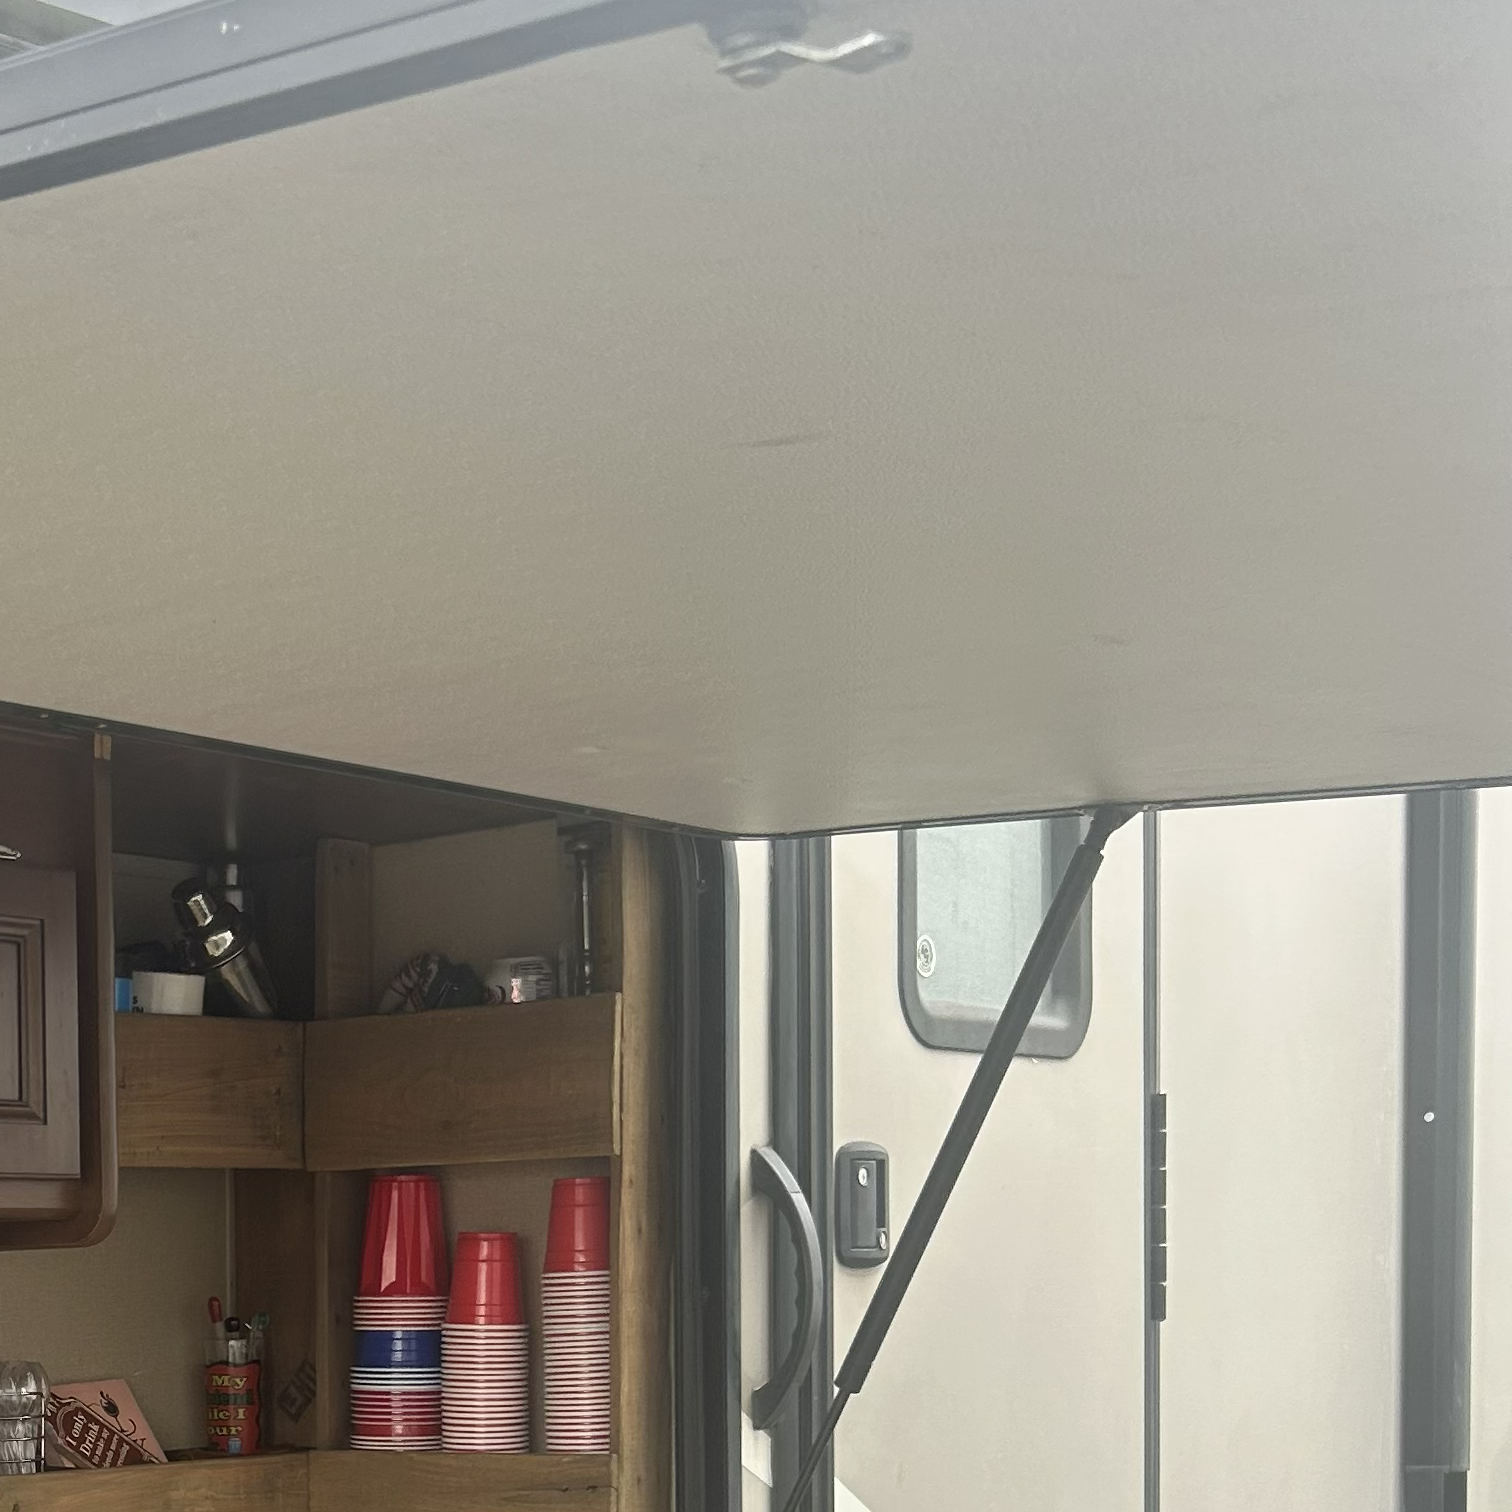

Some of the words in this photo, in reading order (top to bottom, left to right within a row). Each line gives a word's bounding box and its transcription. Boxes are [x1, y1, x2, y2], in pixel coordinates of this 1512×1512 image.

[211, 1375, 248, 1389] My
[71, 1411, 87, 1438] only
[208, 1426, 243, 1436] our
[79, 1422, 100, 1457] Drink
